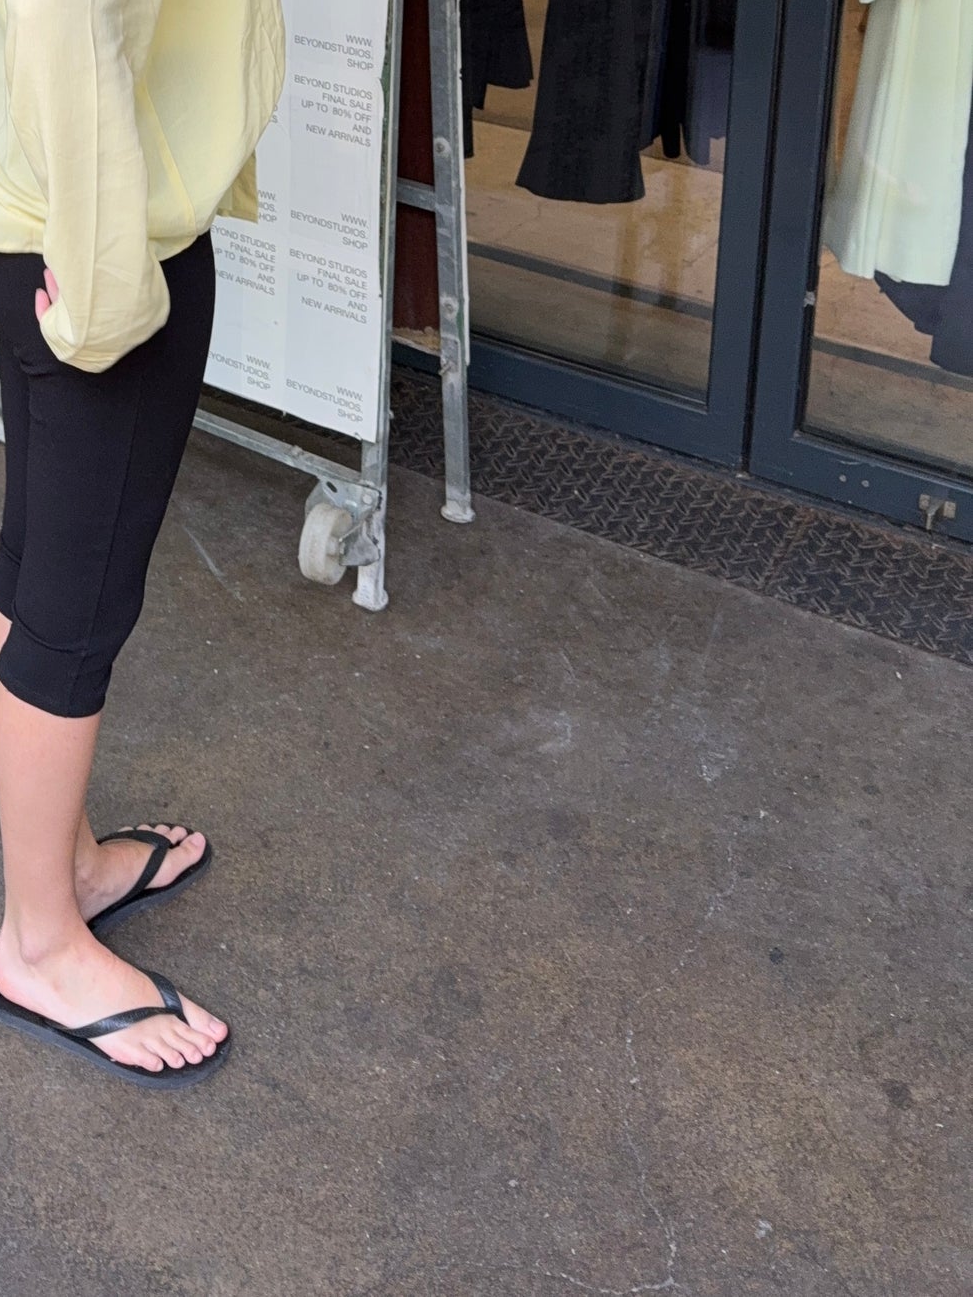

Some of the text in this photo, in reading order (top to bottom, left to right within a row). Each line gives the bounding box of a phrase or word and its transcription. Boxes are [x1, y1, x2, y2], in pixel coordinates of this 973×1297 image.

[294, 34, 374, 60] BEYONDSTUDIOS.
[347, 58, 374, 70] SHOP
[294, 74, 373, 100] BEYOND STUDIOS
[301, 99, 373, 124] UP TO 80% OFF
[322, 92, 372, 112] FINAL SALE
[306, 124, 371, 147] NEW ARRIVALS
[352, 124, 372, 135] AND
[291, 210, 369, 239] BEYONDSTUDIOS.
[230, 241, 275, 263] FINAL SALE
[239, 234, 276, 252] STUDIOS
[342, 236, 368, 250] SHOP
[224, 250, 236, 260] TO
[239, 254, 257, 268] 80%
[259, 262, 275, 273] OFF
[289, 248, 368, 279] BEYOND STUDIOS
[235, 276, 275, 296] ARRIVALS
[257, 272, 275, 285] AND
[297, 272, 368, 300] UP TO 80% OFF
[317, 268, 367, 290] FINAL SALE
[301, 296, 367, 324] NEW ARRIVALS
[347, 300, 368, 312] AND
[247, 376, 271, 390] SHOP
[286, 378, 363, 414] BEYONDSTUDIOS.
[337, 408, 363, 423] SHOP
